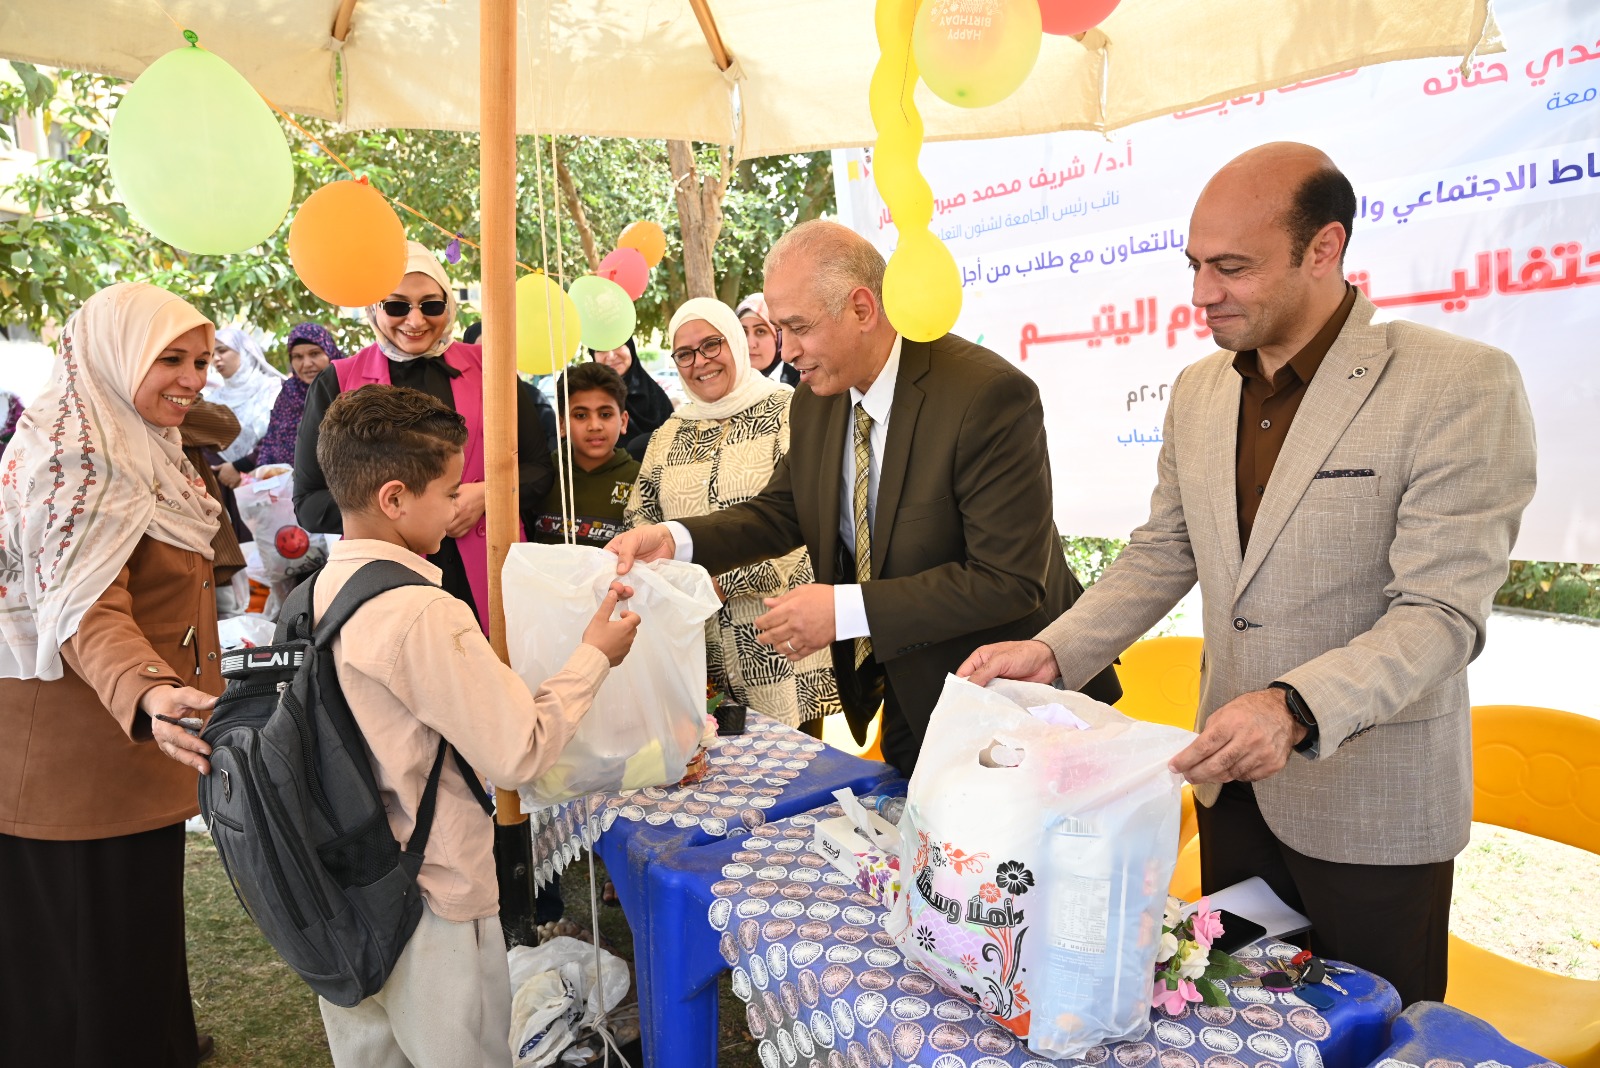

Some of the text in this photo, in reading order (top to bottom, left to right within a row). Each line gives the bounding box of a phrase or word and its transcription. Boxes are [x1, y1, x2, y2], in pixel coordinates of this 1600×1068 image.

[940, 14, 992, 27] BIRTHDAY
[948, 28, 982, 40] HAPPY
[1525, 40, 1600, 87] دي
[1546, 87, 1598, 111] معة
[1029, 155, 1085, 190] شريف
[1548, 152, 1600, 185] اط
[972, 178, 1022, 203] محمد
[1091, 190, 1120, 210] نائب
[1392, 162, 1537, 224] الاجتماعي
[933, 192, 966, 217] صبر
[1004, 205, 1049, 227] الجامعة
[1052, 197, 1088, 221] رئيس
[964, 215, 1002, 239] لشئون
[1100, 229, 1184, 265] بالتعاون
[962, 257, 982, 288] أجل
[986, 263, 1011, 283] من
[1015, 251, 1064, 277] طلاب
[1069, 250, 1094, 274] مع
[1019, 296, 1158, 361] اليتيم
[1166, 303, 1213, 349] وم
[1117, 426, 1164, 447] شباب
